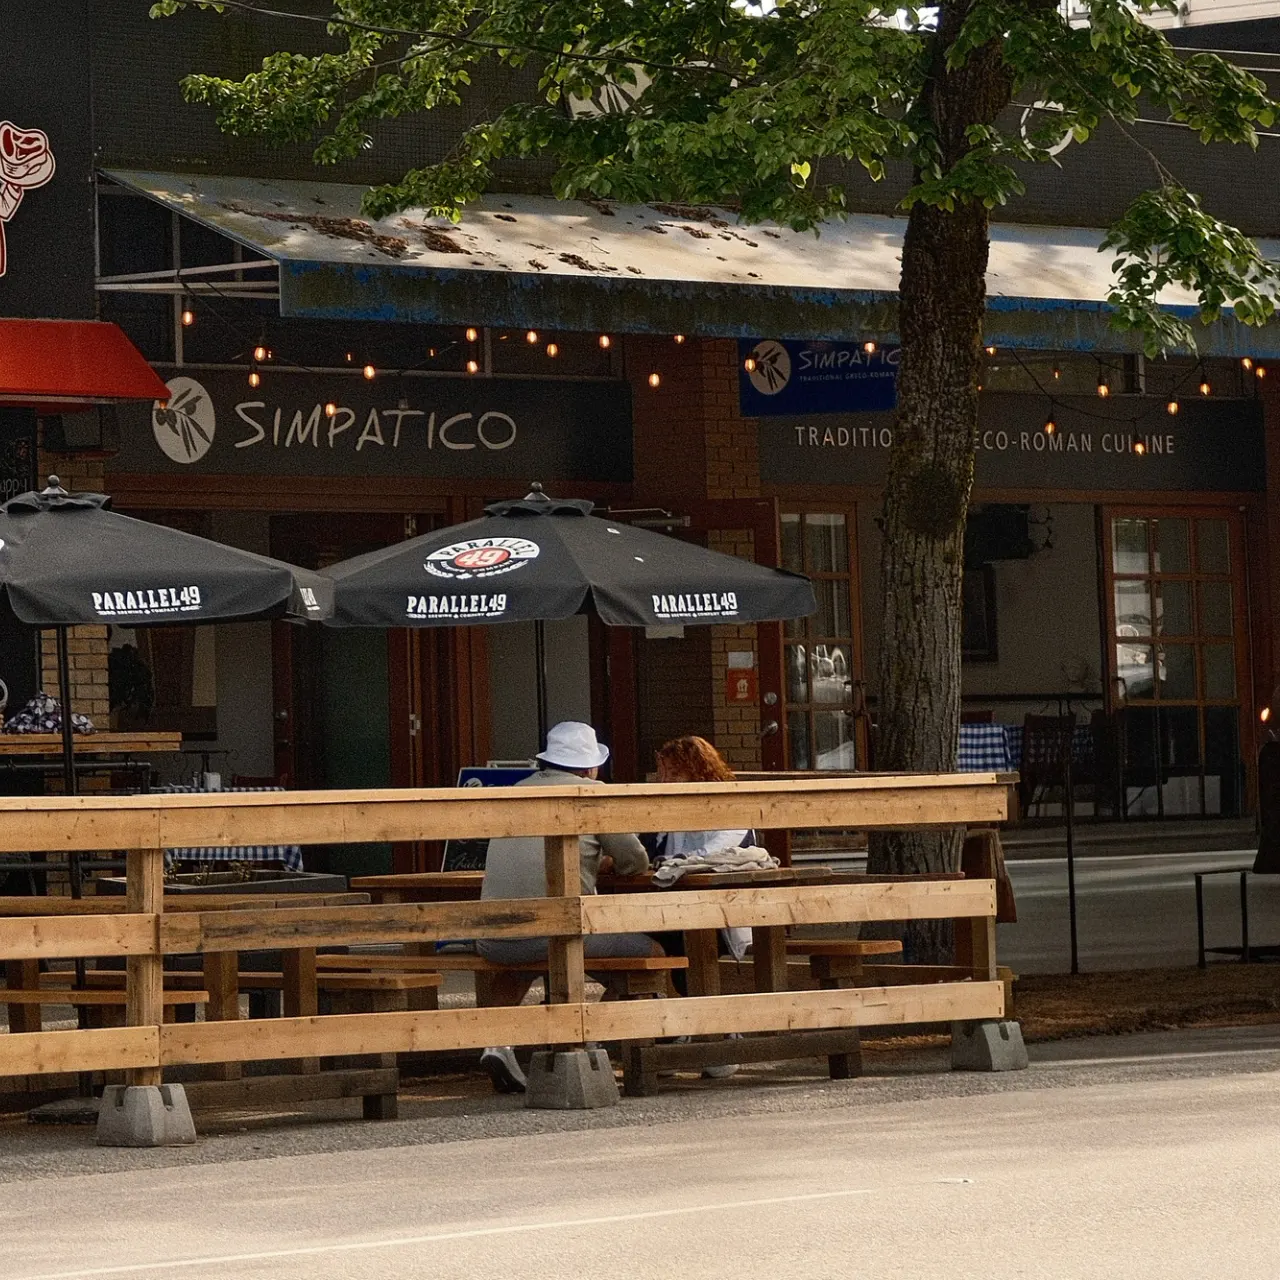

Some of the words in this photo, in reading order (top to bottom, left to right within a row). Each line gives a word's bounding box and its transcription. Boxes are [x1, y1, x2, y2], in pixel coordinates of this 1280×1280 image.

[798, 349, 901, 371] SIMPATIC
[234, 401, 517, 450] SIMPATICO
[1101, 433, 1175, 454] CUIINE
[459, 548, 504, 567] 49
